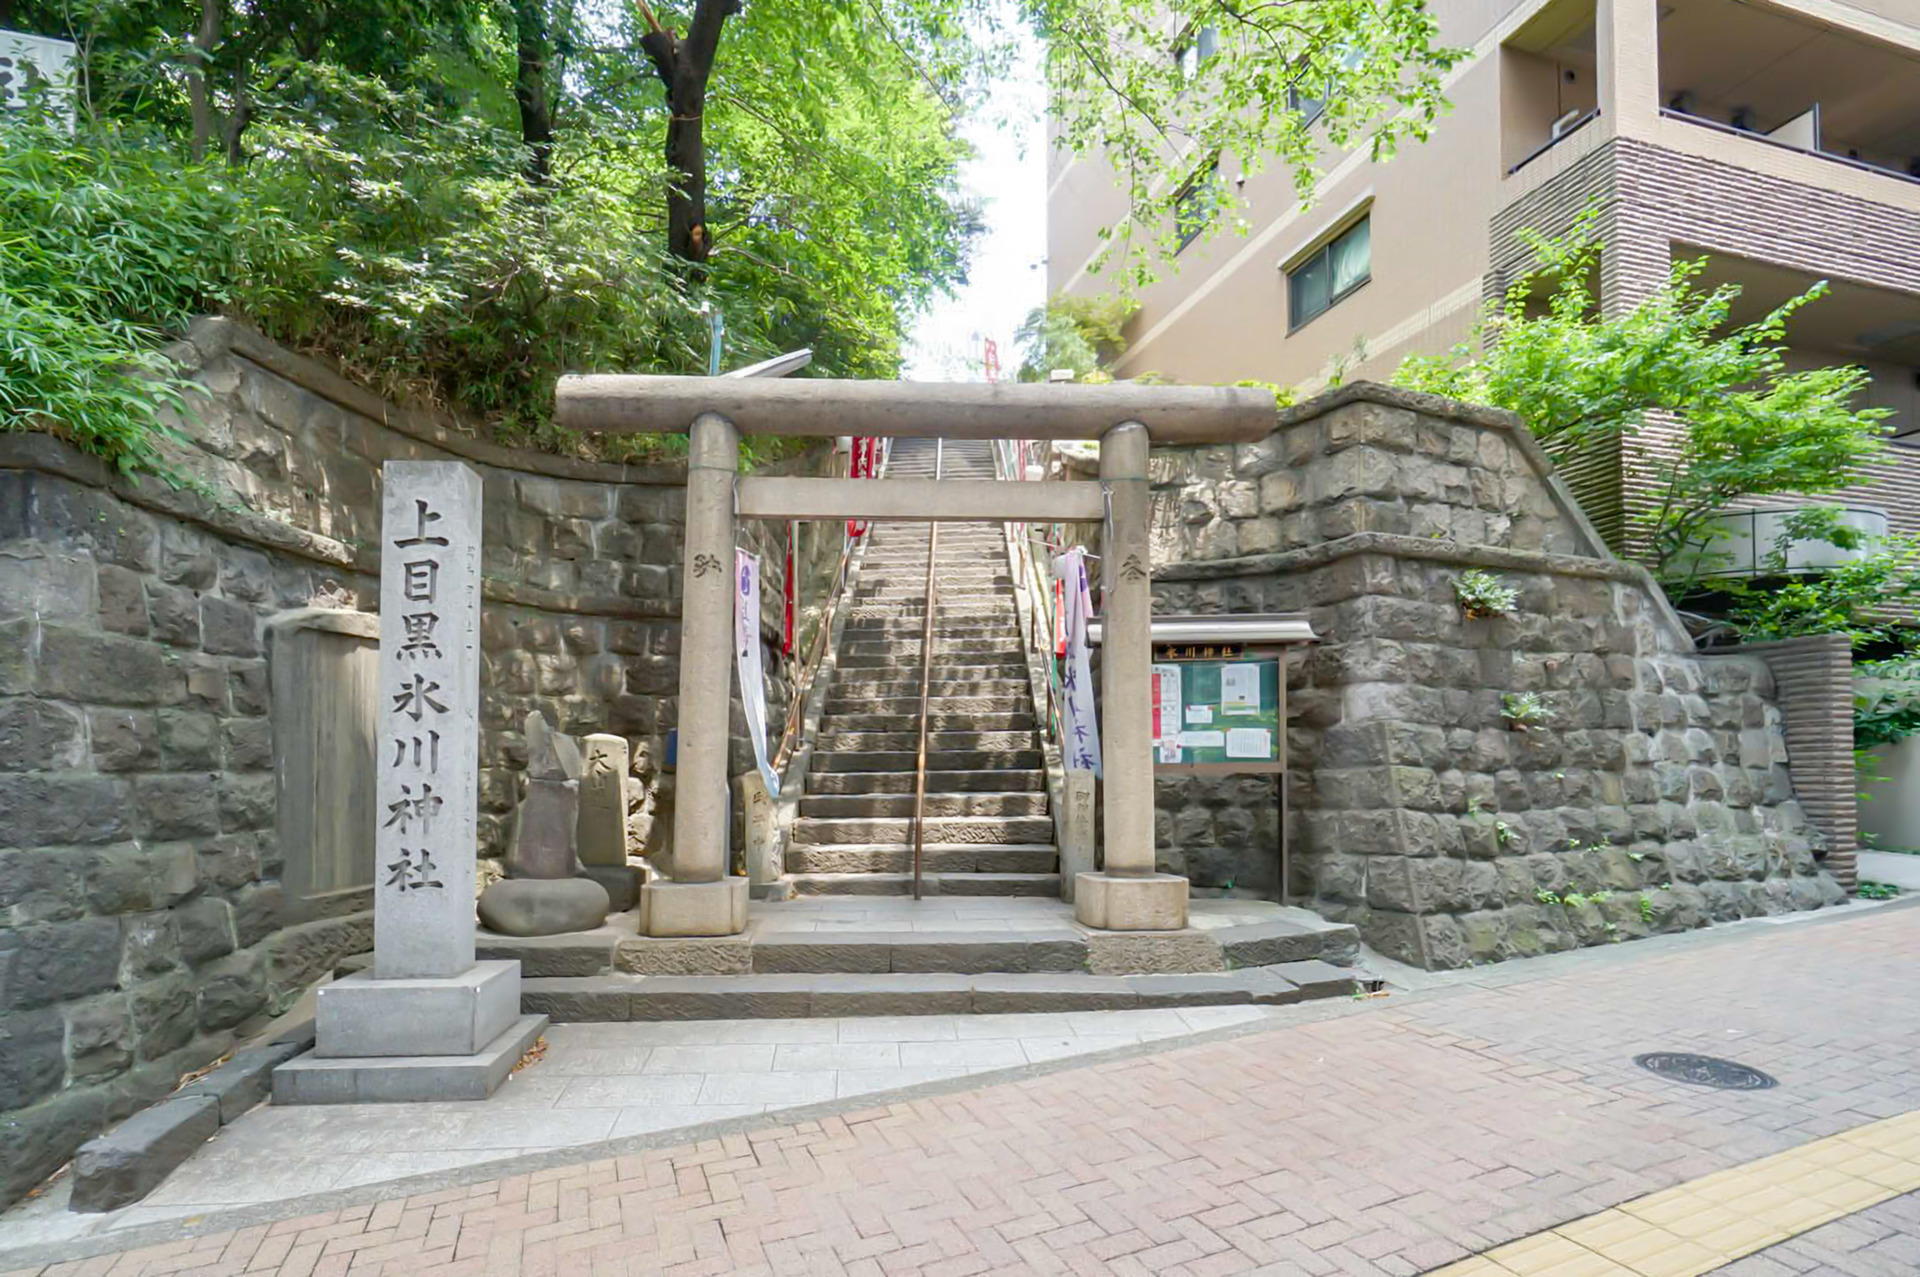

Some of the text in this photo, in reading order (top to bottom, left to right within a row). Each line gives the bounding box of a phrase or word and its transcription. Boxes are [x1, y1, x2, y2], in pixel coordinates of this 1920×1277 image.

[382, 498, 449, 892] 上目黒氷川神社
[1165, 646, 1234, 659] 氷川神社
